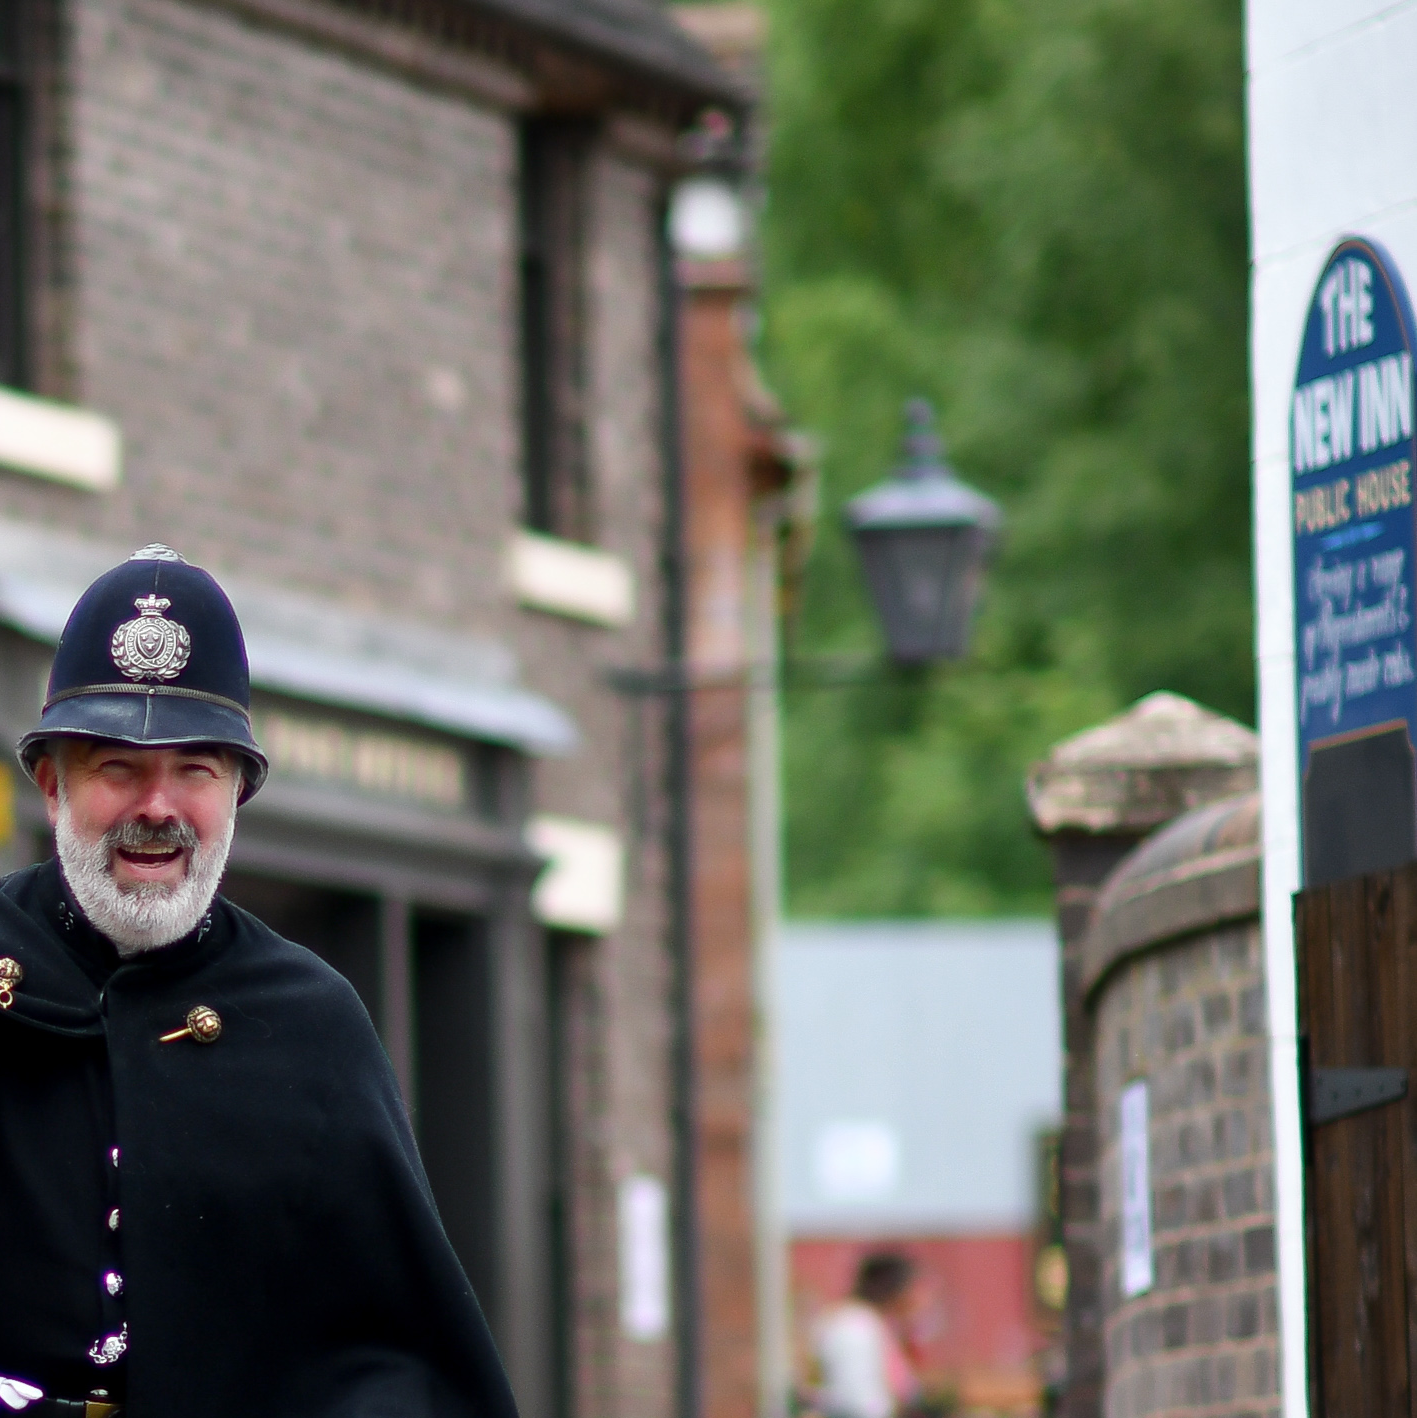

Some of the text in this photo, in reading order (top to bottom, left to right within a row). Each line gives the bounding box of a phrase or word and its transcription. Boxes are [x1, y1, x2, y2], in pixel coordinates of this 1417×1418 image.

[1321, 258, 1374, 355] THE
[1294, 351, 1412, 475] NEW INN
[1295, 460, 1411, 536] PUBLIC HOUSE
